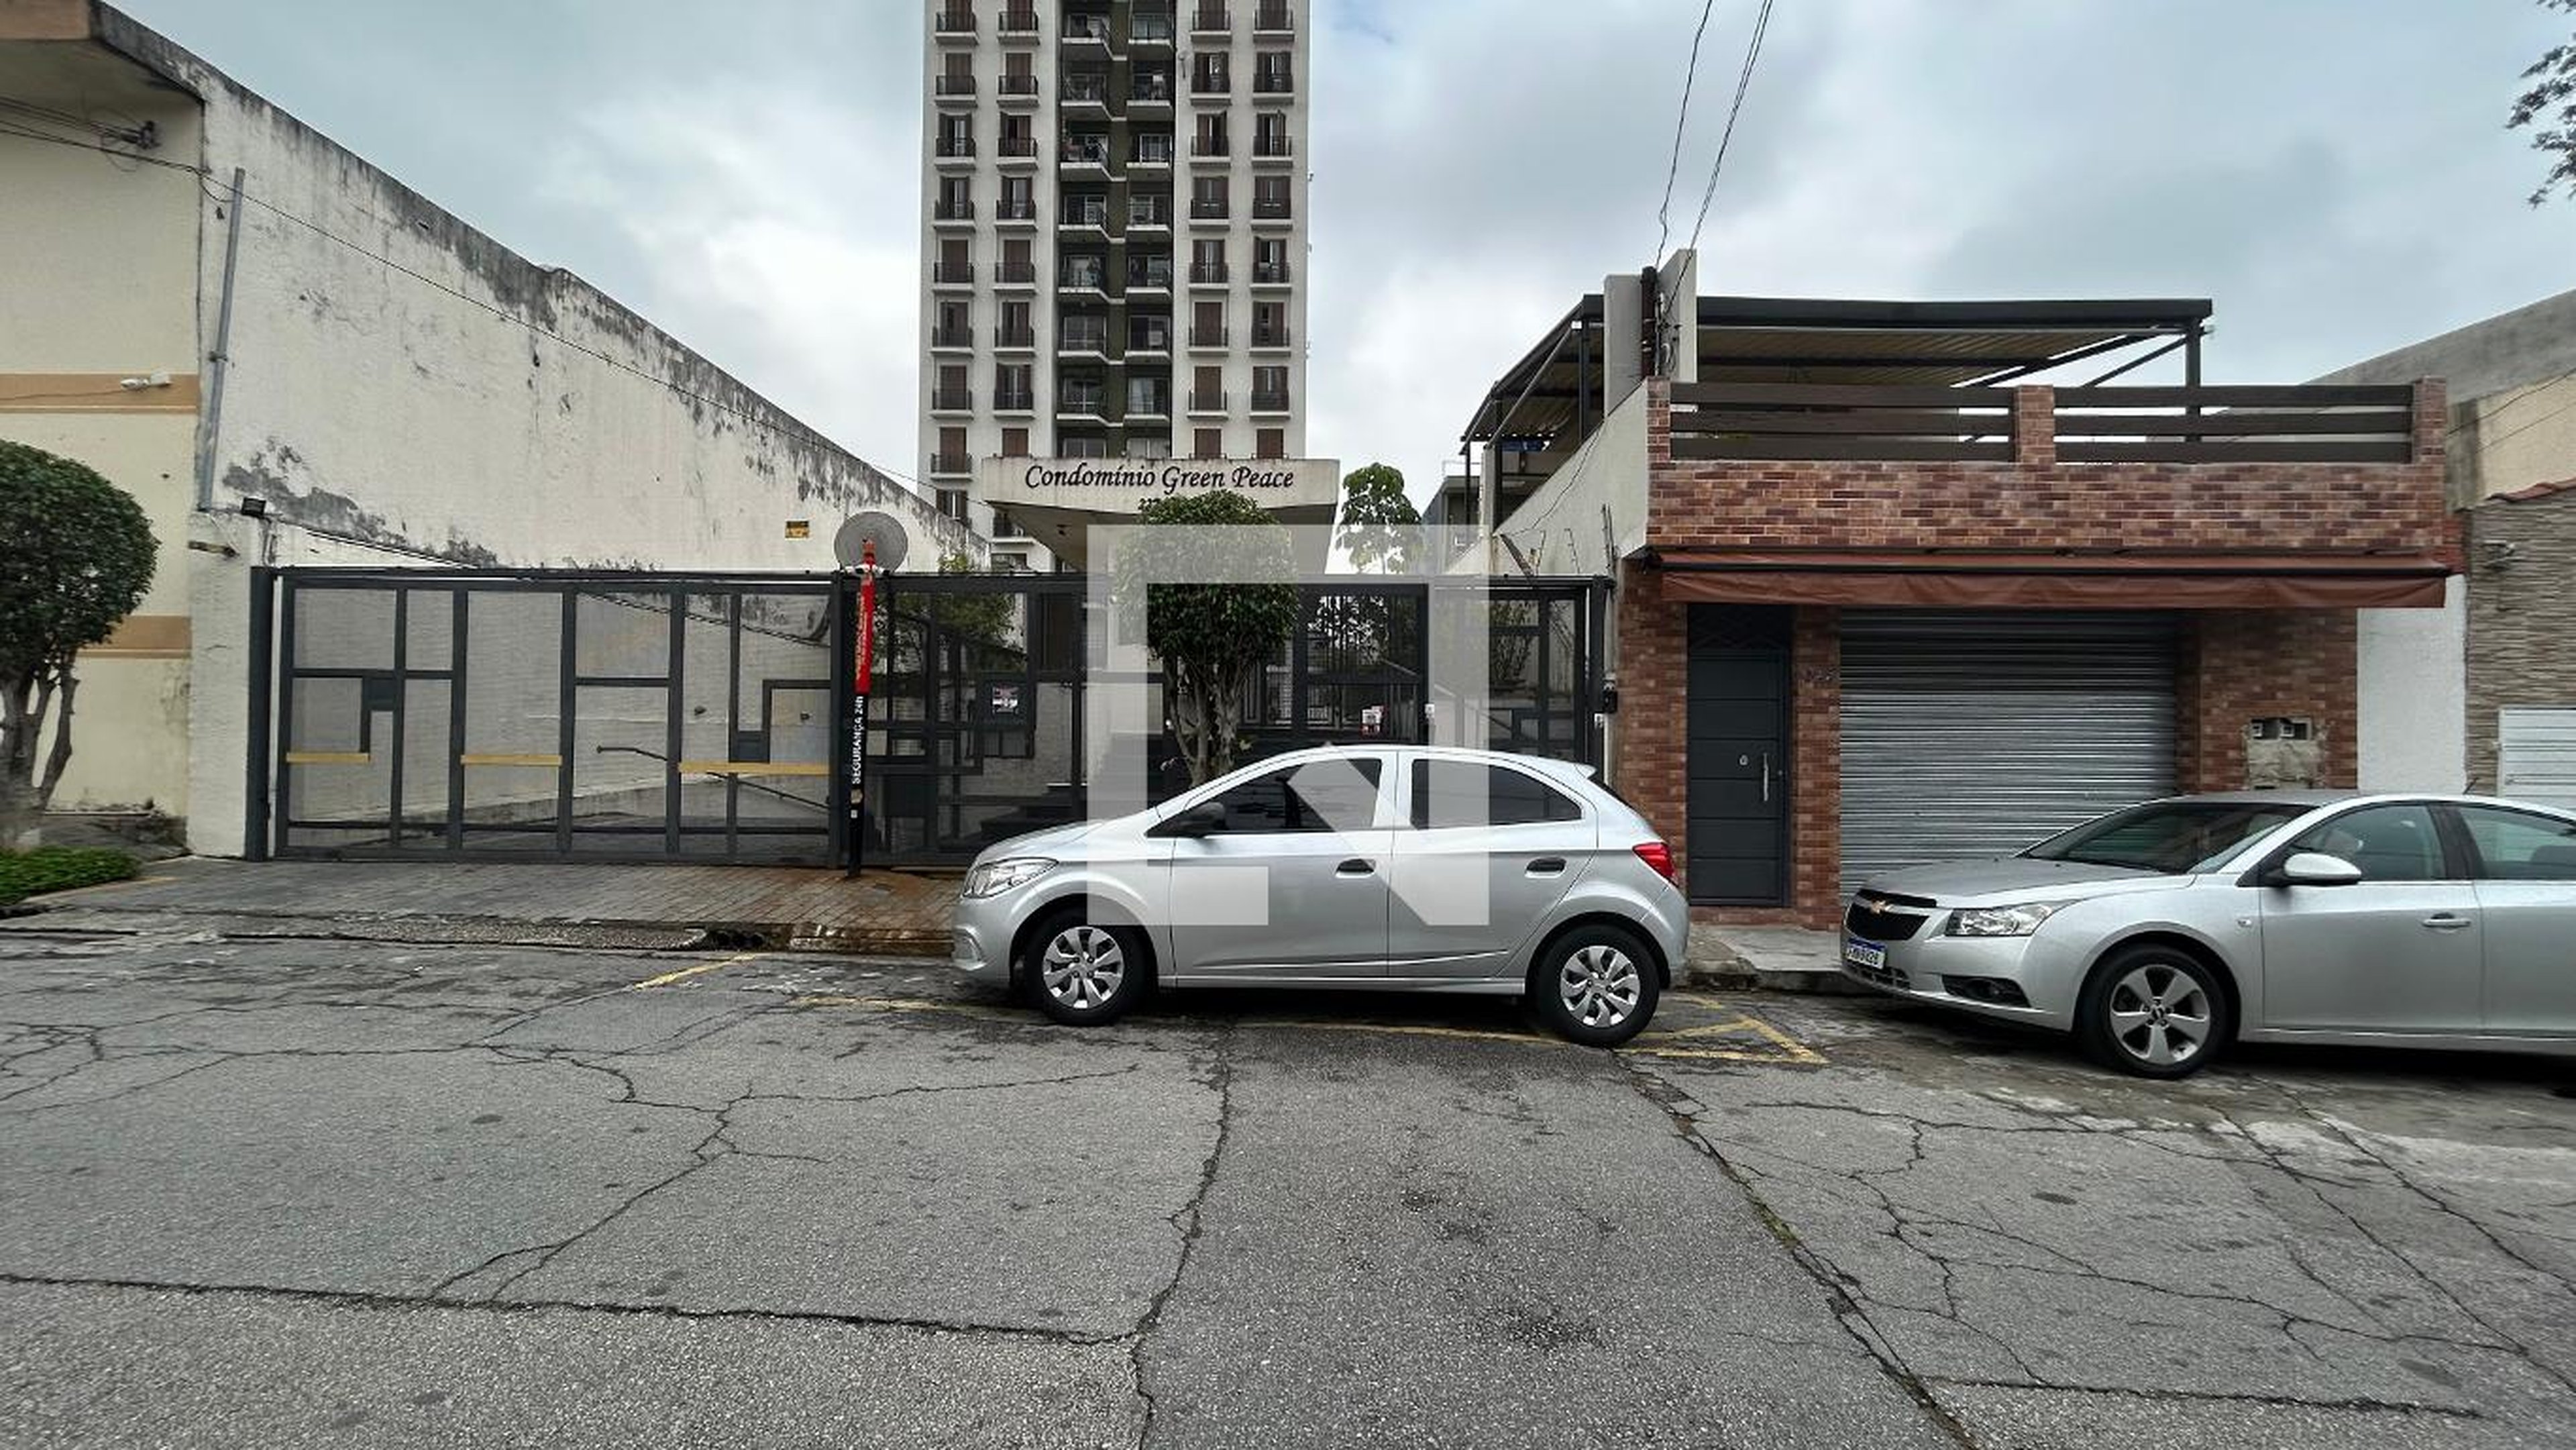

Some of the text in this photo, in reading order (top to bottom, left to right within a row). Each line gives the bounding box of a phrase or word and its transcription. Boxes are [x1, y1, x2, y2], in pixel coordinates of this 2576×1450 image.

[1025, 462, 1295, 495] Condomínio Green Peace
[851, 696, 865, 785] SEGURANÇA 24h
